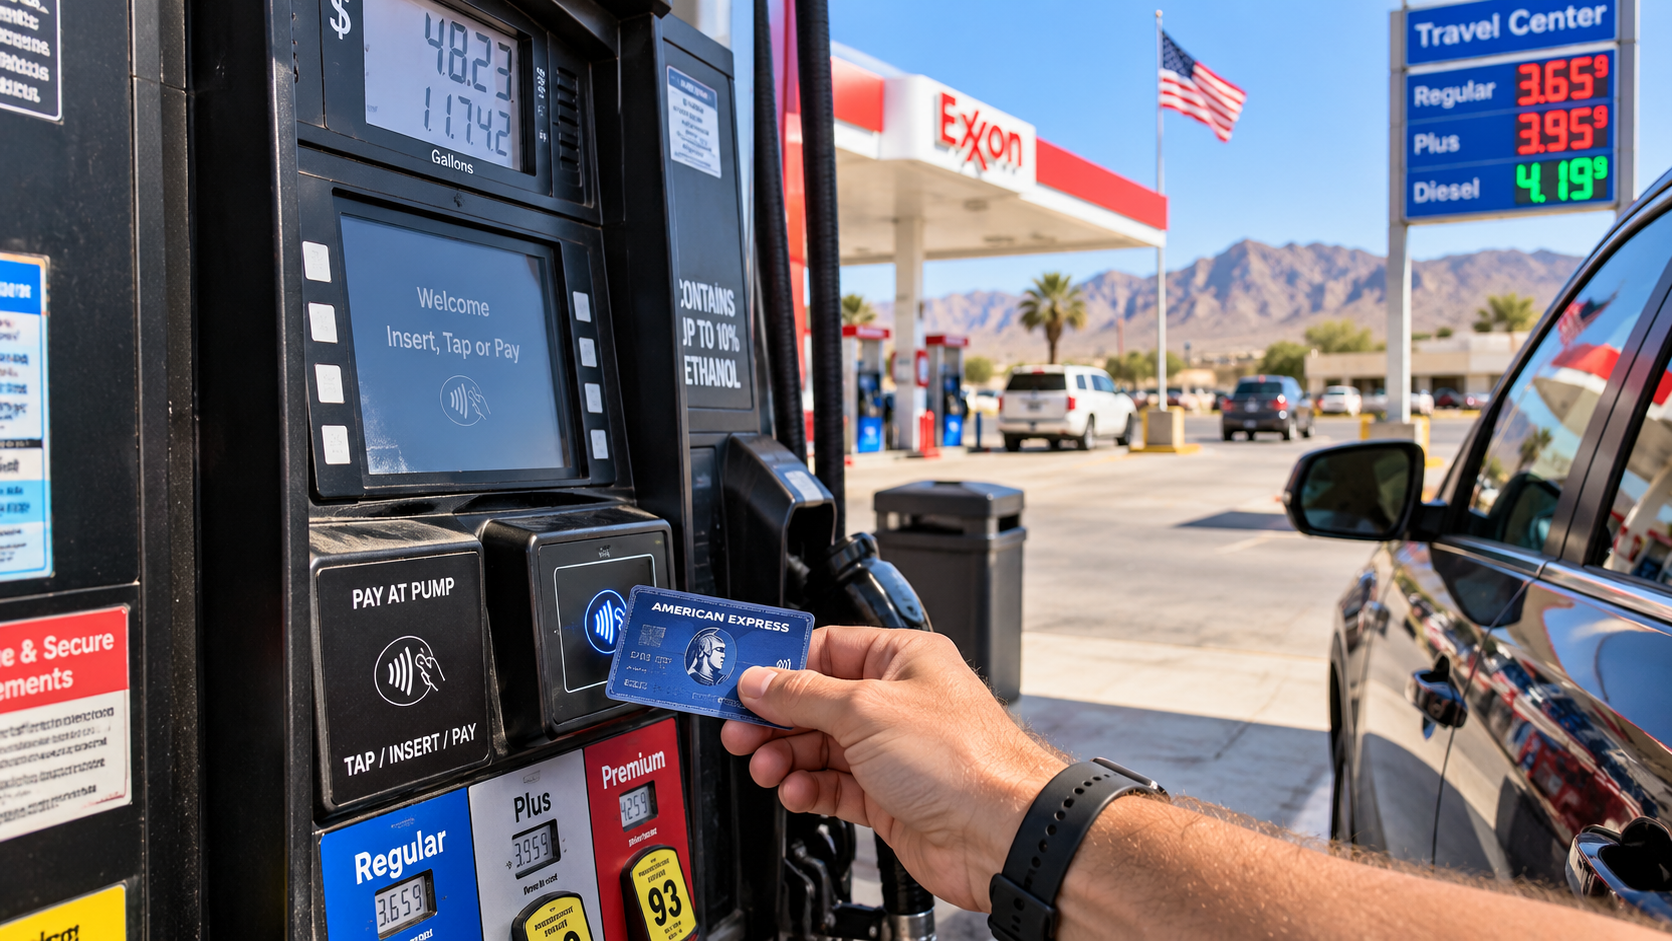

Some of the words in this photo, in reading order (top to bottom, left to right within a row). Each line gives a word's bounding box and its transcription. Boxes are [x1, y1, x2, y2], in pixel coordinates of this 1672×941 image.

[330, 0, 351, 40] $
[1413, 12, 1500, 48] Travel
[1508, 4, 1608, 37] Center
[1413, 79, 1497, 109] Regular
[940, 91, 1022, 171] Exxon
[1413, 131, 1461, 156] Plus
[431, 148, 474, 175] Gallons
[1412, 176, 1480, 204] Diesel
[416, 286, 490, 317] Welcome
[386, 325, 440, 355] Insert,
[443, 331, 472, 359] Tap
[475, 340, 491, 357] or
[494, 338, 520, 364] Pay
[696, 319, 715, 350] TO
[716, 322, 741, 353] 10%
[684, 354, 742, 389] ETHANOL
[352, 585, 384, 610] PAY
[387, 582, 408, 605] AT
[411, 577, 456, 601] PUMP
[651, 602, 725, 623] AMERICAN
[727, 614, 790, 633] EXPRESS
[20, 638, 37, 664] &
[43, 632, 115, 660] Secure
[343, 751, 375, 777] TAP
[389, 733, 440, 765] INSERT
[452, 722, 477, 746] PAY
[601, 749, 666, 790] Premium
[513, 791, 552, 823] Plus
[354, 829, 447, 885] Regular
[648, 878, 683, 928] 93
